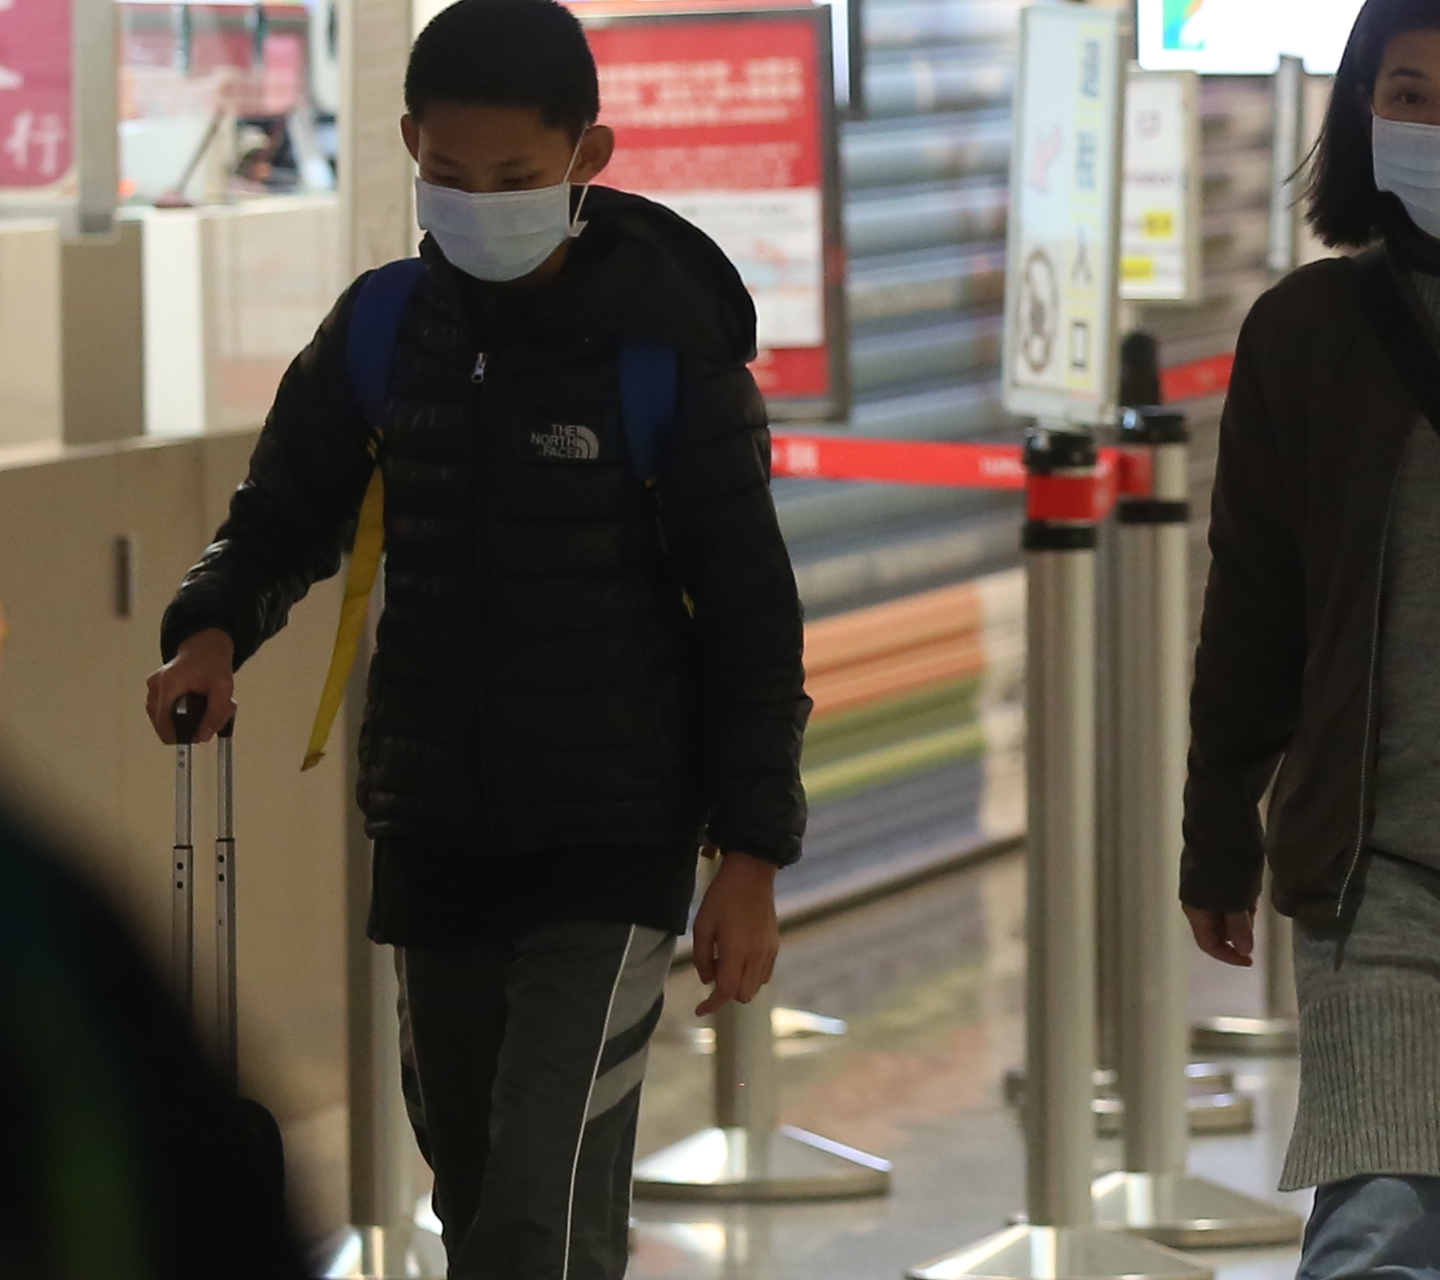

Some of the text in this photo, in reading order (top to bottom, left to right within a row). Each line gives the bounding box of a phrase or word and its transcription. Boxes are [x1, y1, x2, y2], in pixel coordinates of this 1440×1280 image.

[551, 424, 577, 436] THE
[531, 432, 576, 448] NORTH
[543, 445, 576, 458] FACE
